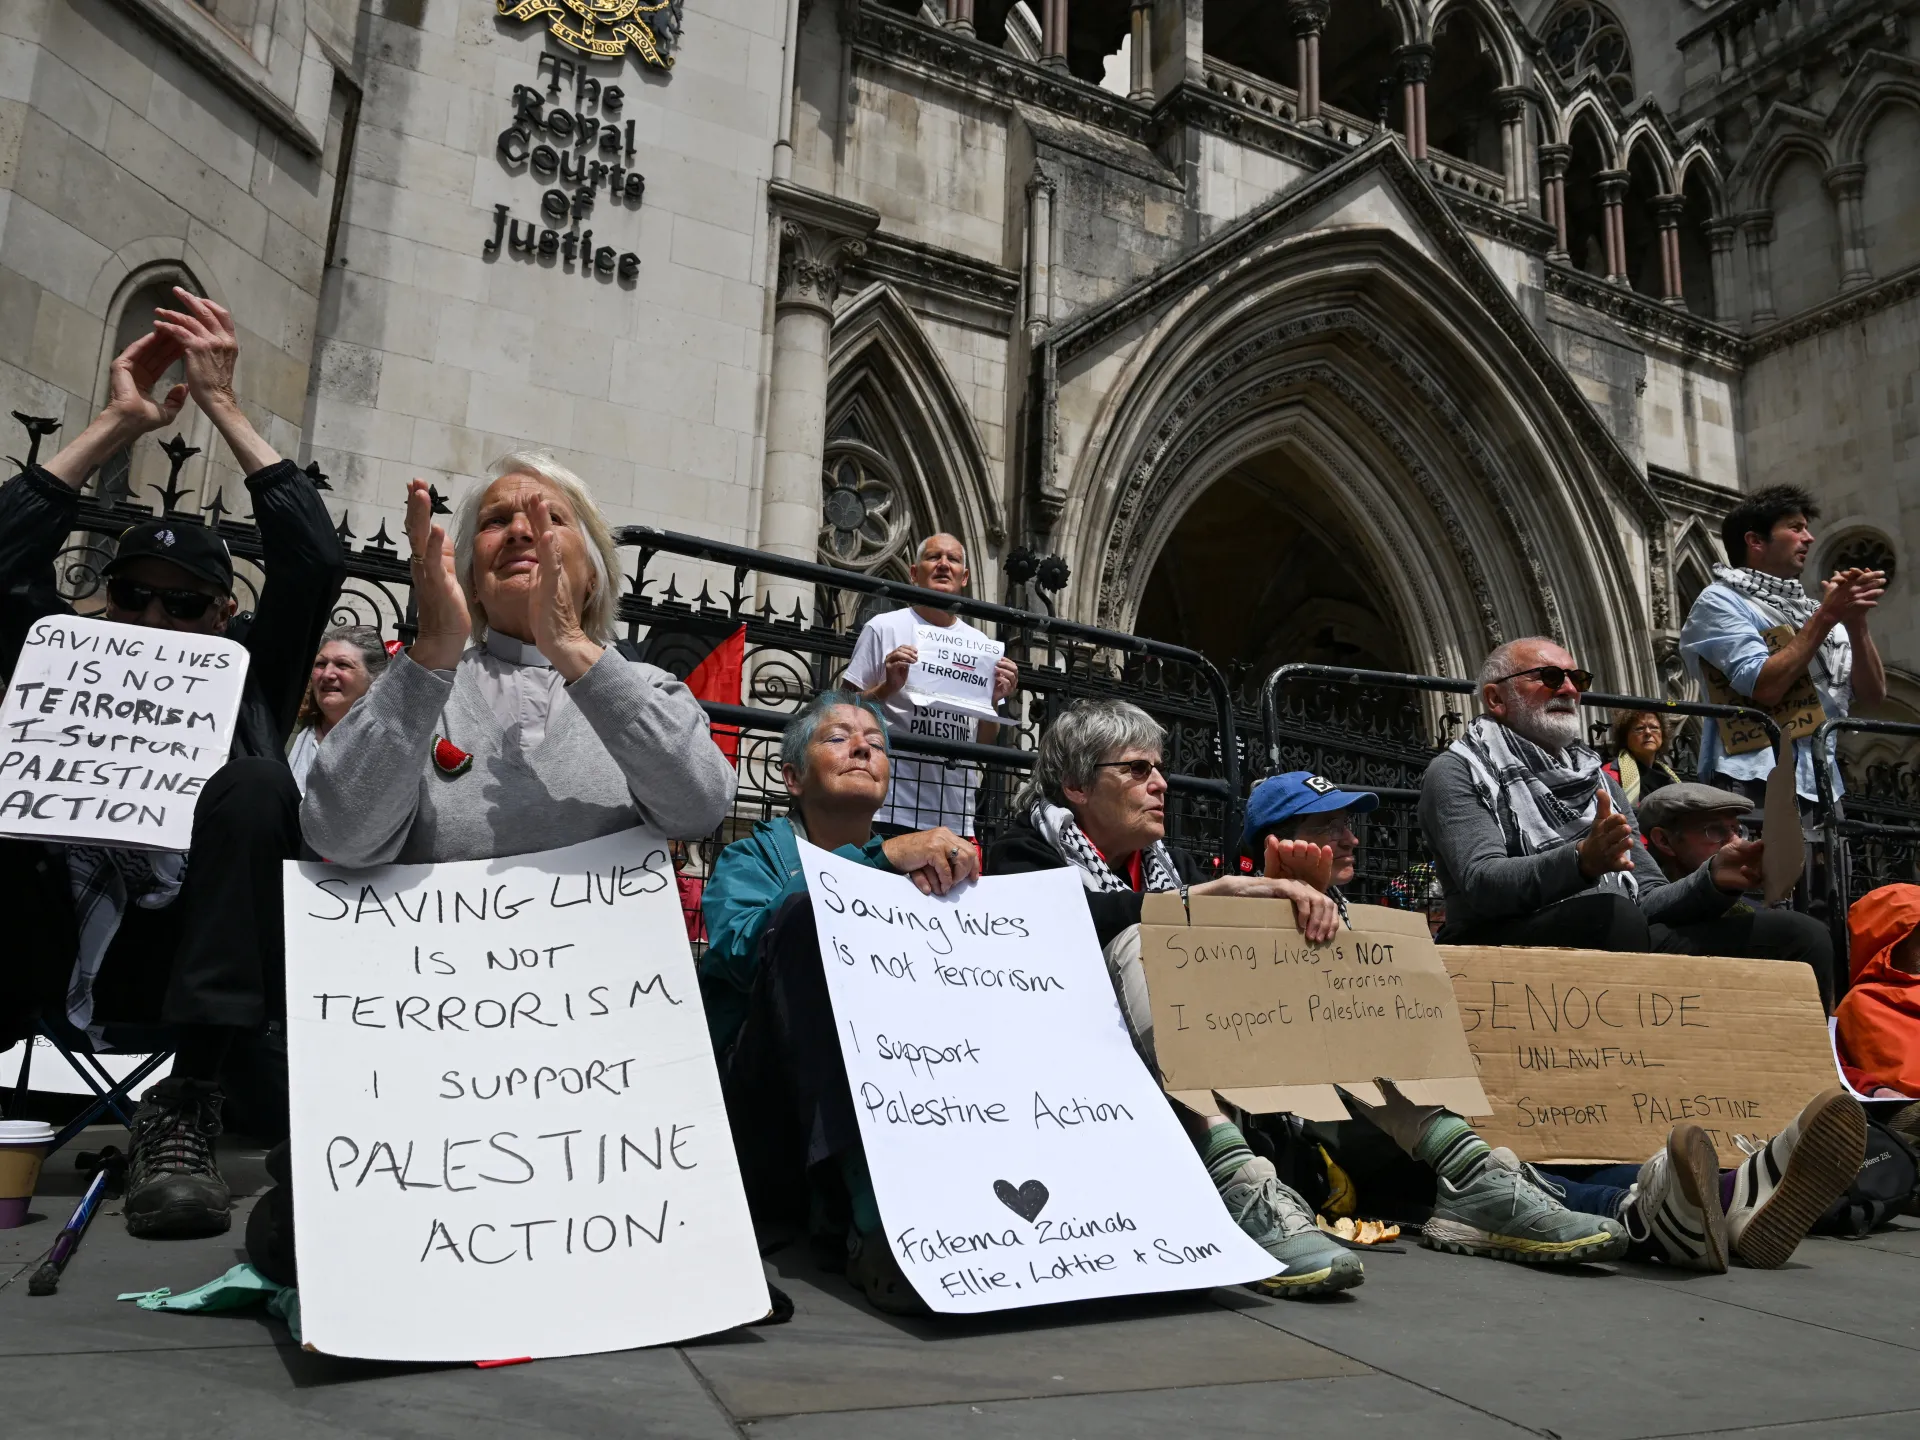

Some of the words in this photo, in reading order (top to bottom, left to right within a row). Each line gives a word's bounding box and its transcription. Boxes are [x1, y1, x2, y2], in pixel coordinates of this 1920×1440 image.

[622, 23, 660, 63] DROIT
[539, 51, 625, 111] The
[513, 84, 637, 155] Royal
[497, 126, 645, 197] Courts
[542, 188, 596, 221] of
[484, 204, 641, 279] Justice
[26, 625, 144, 657] SAVING
[155, 645, 230, 669] LIVES
[918, 630, 963, 647] SAVING
[967, 640, 1000, 655] LIVES
[938, 649, 949, 660] IS
[952, 653, 978, 667] NOT
[67, 661, 102, 684] IS
[123, 670, 209, 694] NOT
[921, 661, 988, 688] TERRORISM
[16, 682, 216, 732] TERRORISM
[8, 718, 56, 743] I
[910, 719, 970, 742] PALESTINE
[0, 751, 208, 796] PALESTINE
[0, 790, 166, 827] ACTION
[309, 879, 534, 927] SAVING
[550, 849, 667, 908] LIVES
[819, 870, 952, 954] Saving
[956, 909, 1029, 938] lives
[415, 946, 456, 975] IS
[487, 944, 575, 970] NOT
[833, 936, 855, 966] is
[870, 952, 914, 983] not
[934, 957, 1064, 992] terrorism
[1167, 933, 1257, 969] Saving
[1274, 939, 1320, 965] Lives
[1356, 943, 1394, 966] NOT
[1322, 970, 1403, 990] Terrorism
[313, 974, 683, 1031] TERRORISM
[1170, 1004, 1190, 1031] I
[1206, 1000, 1293, 1041] support
[1308, 994, 1385, 1022] Palestine
[1395, 995, 1444, 1021] Action
[849, 1020, 861, 1053] I
[877, 1033, 981, 1079] support
[1518, 1045, 1664, 1070] UNLAWFUL
[373, 1070, 379, 1099] I
[440, 1058, 636, 1100] SUPPORT
[860, 1081, 1010, 1126] Palestine
[1034, 1091, 1134, 1130] Action
[1517, 1096, 1608, 1128] SUPPORT
[1632, 1092, 1761, 1125] PALESTINE
[327, 1124, 698, 1192] PALESTINE
[897, 1226, 1024, 1265] Fatema
[1035, 1211, 1137, 1245] Zainab
[940, 1263, 1021, 1298] Ellie,
[1029, 1252, 1118, 1285] Lottie
[1153, 1238, 1222, 1266] Sam
